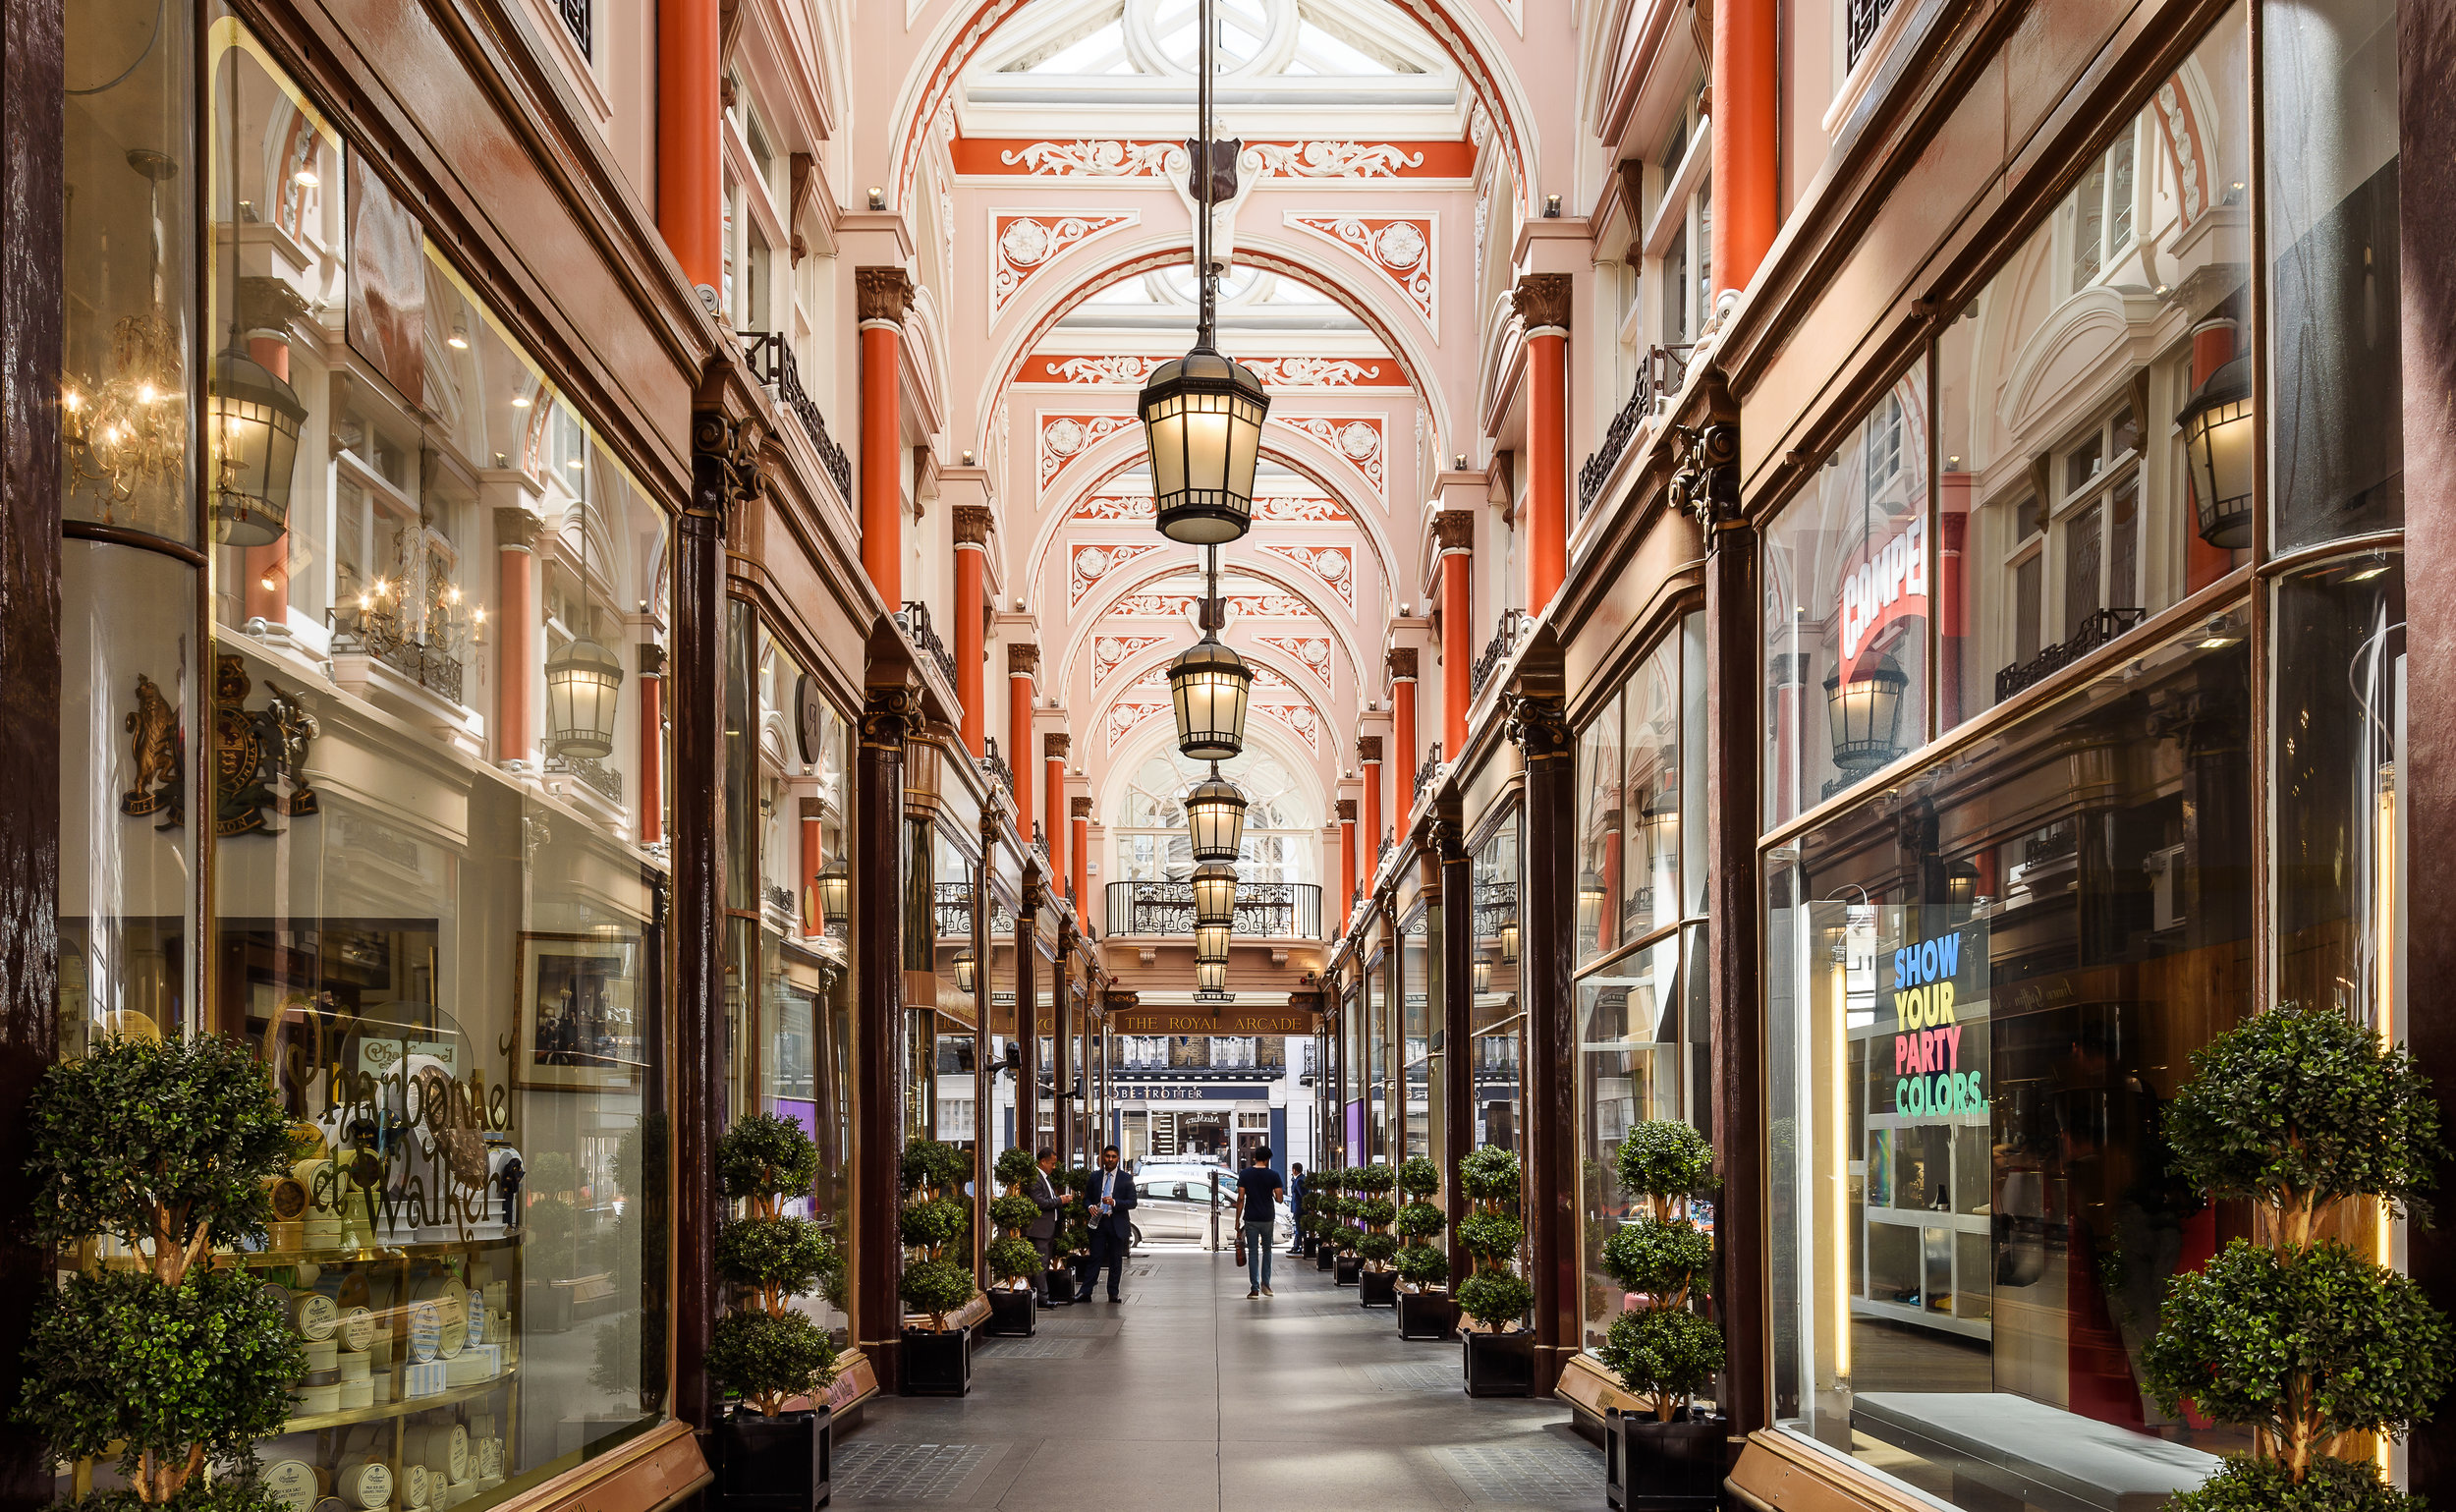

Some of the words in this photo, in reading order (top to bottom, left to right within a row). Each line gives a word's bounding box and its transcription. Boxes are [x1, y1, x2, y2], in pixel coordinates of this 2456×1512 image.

[1894, 932, 1960, 989] SHOW
[1125, 1017, 1158, 1031] THE
[1169, 1017, 1222, 1031] ROYAL
[1234, 1017, 1303, 1031] ARCADE
[1894, 981, 1955, 1032] YOUR
[1895, 1025, 1962, 1076] PARTY
[1895, 1070, 1988, 1118] COLORS.
[353, 1135, 501, 1243] Walker
